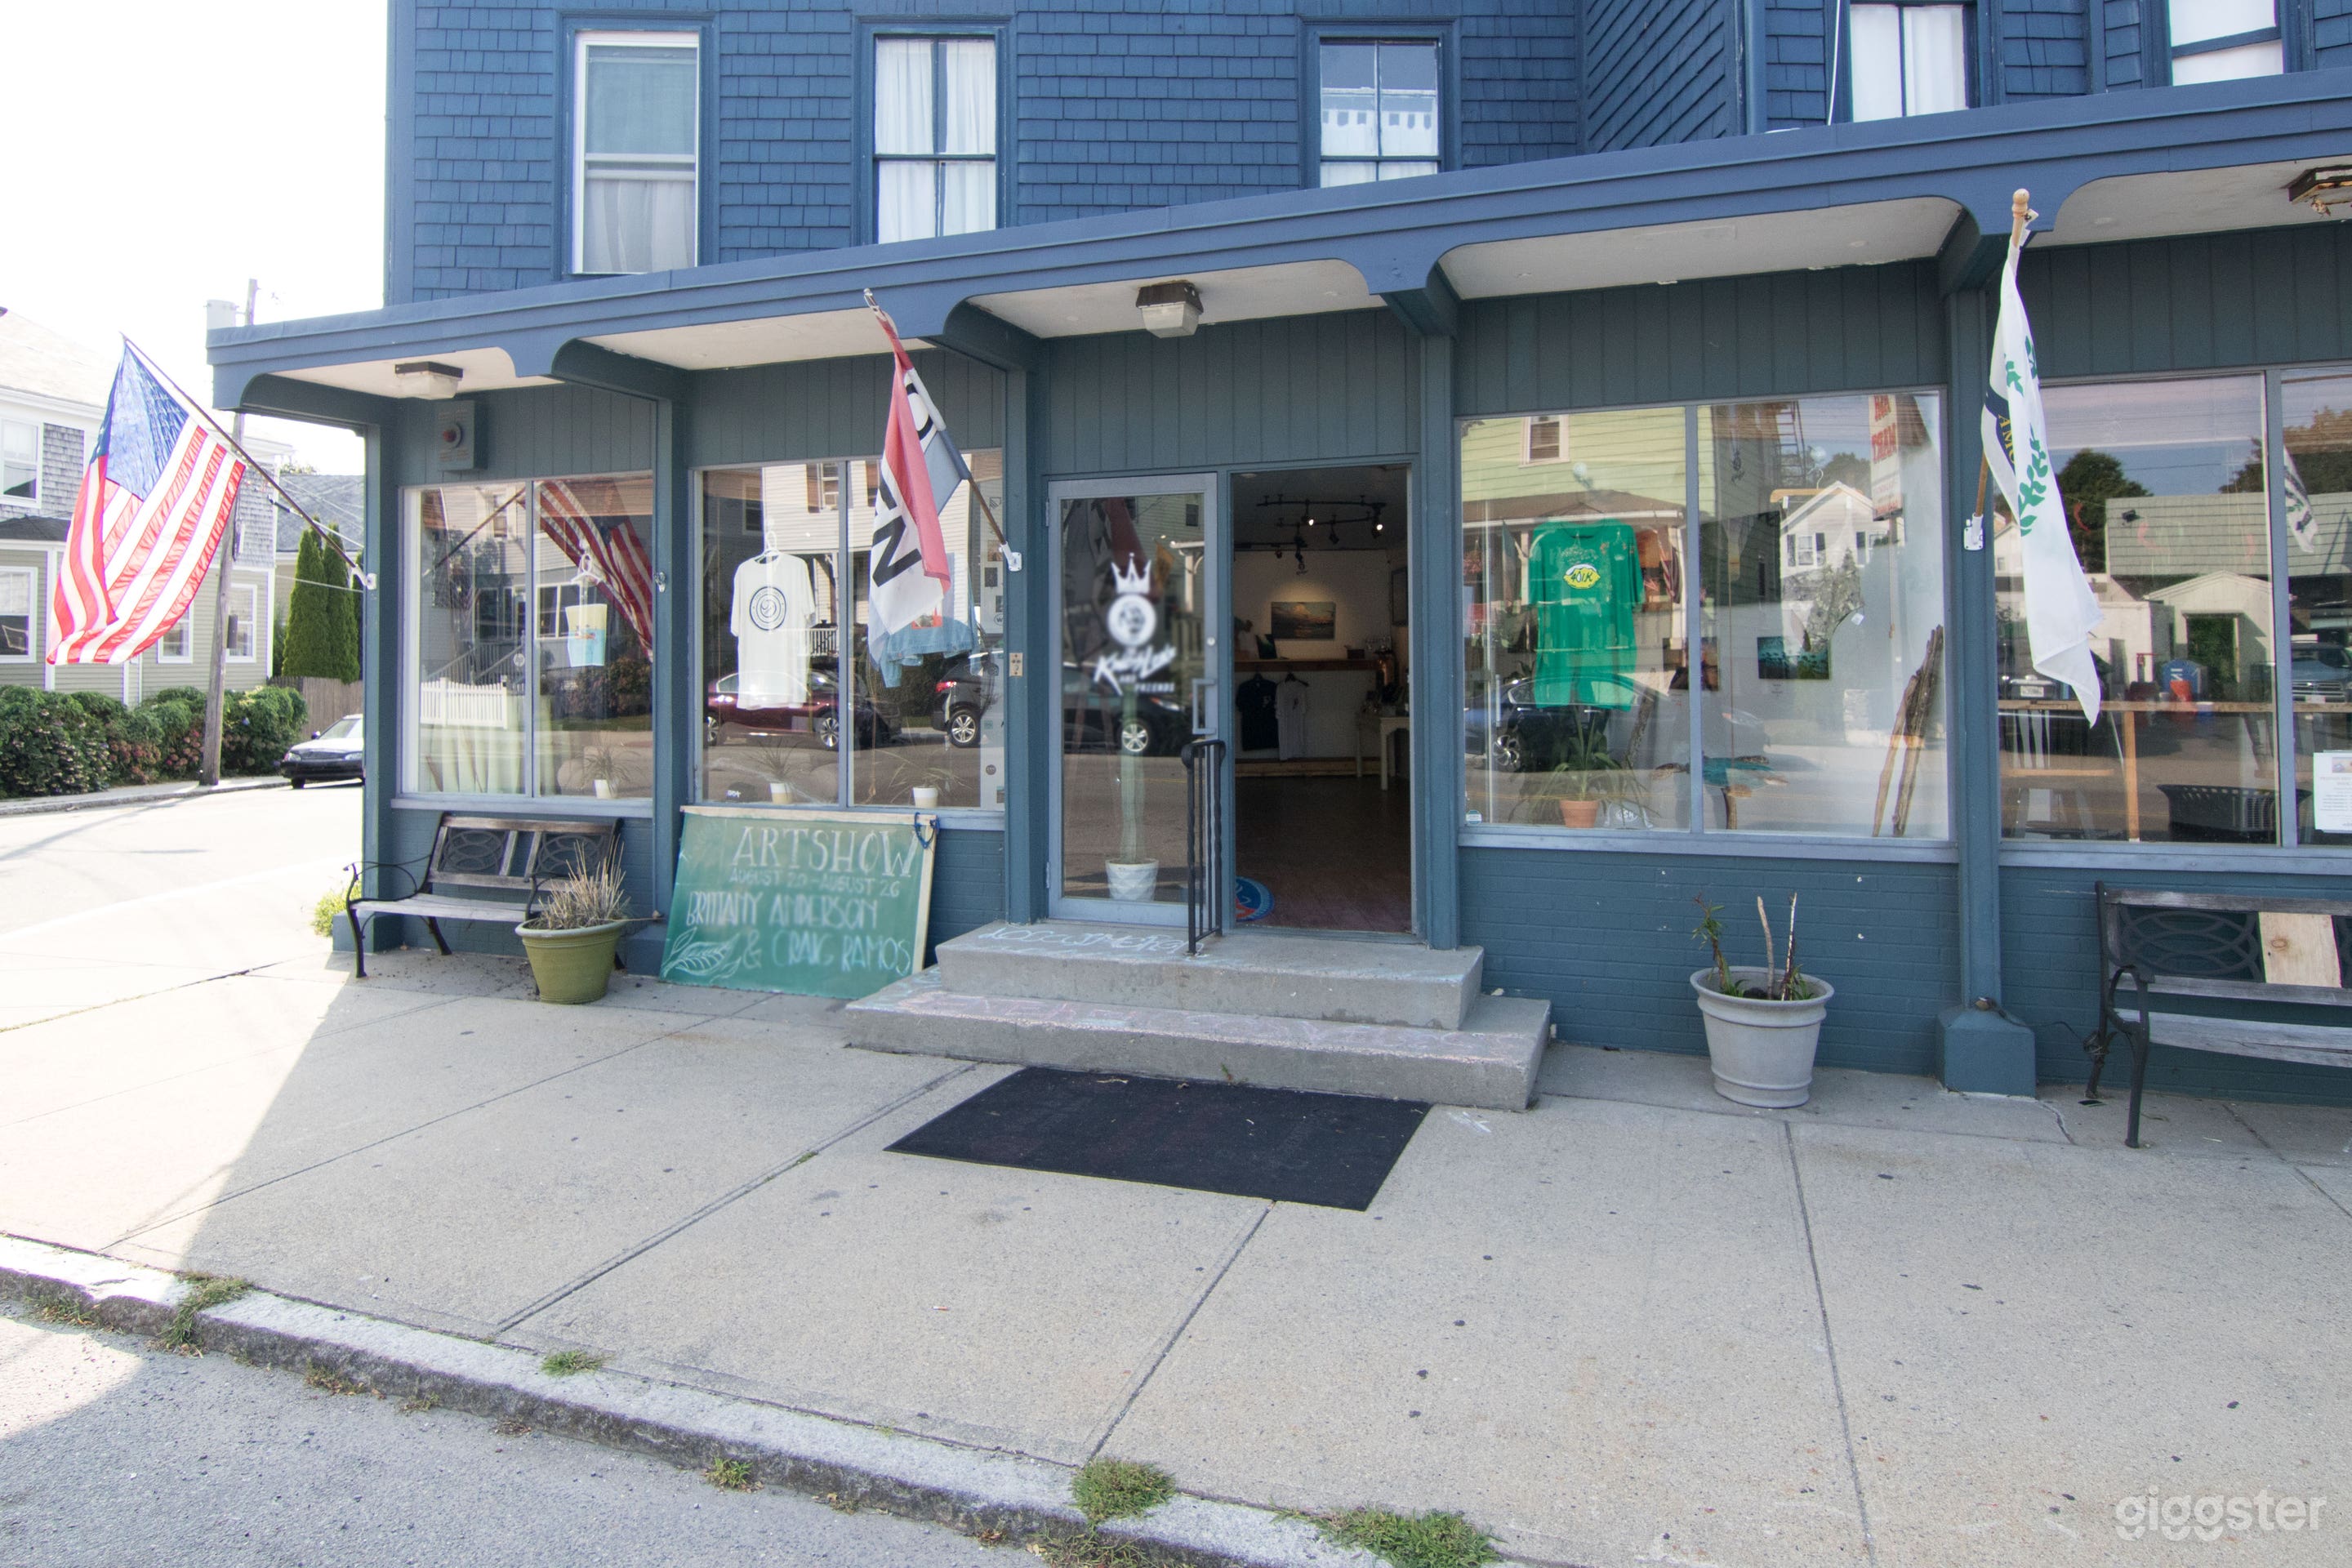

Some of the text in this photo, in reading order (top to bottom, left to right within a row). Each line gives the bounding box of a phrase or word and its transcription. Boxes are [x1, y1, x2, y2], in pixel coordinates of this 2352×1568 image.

[728, 869, 783, 886] AUGUST
[818, 874, 875, 896] AUGUST
[743, 929, 911, 977] & CRAIG RAMOS
